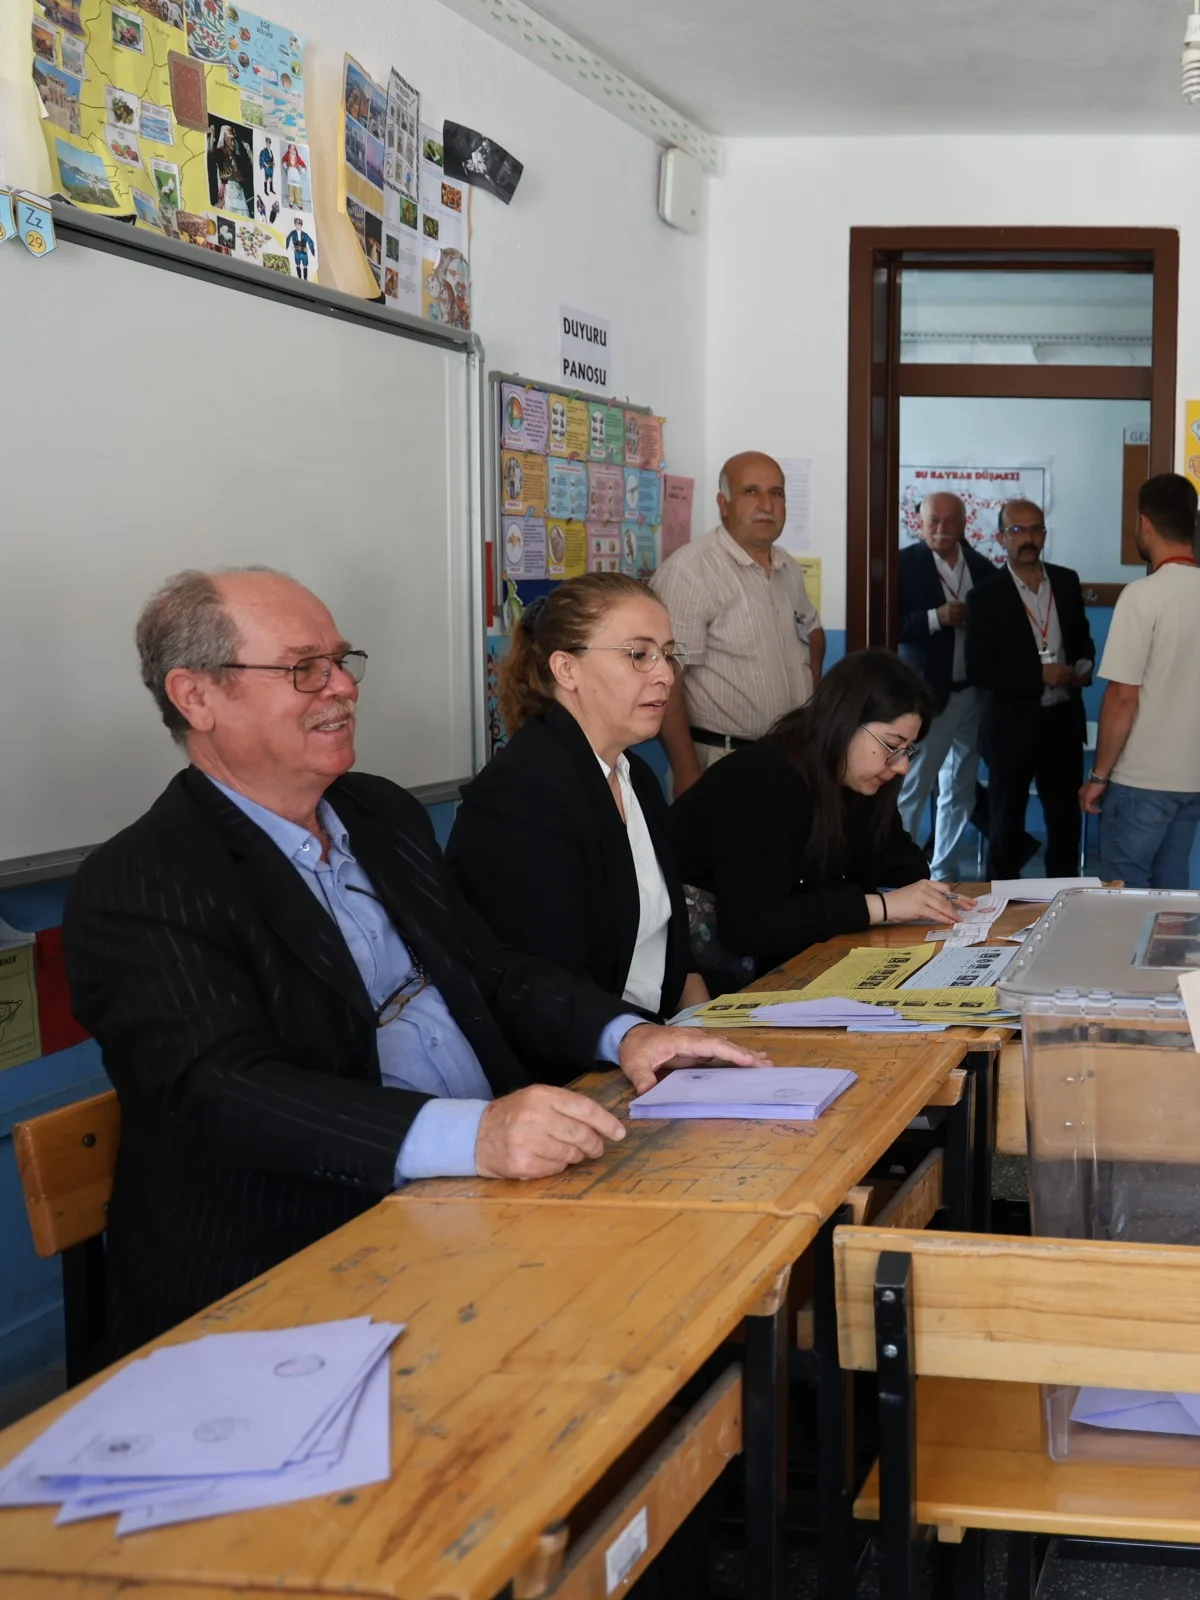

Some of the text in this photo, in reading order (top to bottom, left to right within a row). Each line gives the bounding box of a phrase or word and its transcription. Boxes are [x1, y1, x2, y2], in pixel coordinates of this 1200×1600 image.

[25, 207, 43, 228] Zz
[28, 235, 43, 248] 29
[563, 317, 606, 347] DUYURU
[563, 358, 606, 385] PANOSU
[916, 471, 927, 479] BU
[931, 472, 972, 480] BAYRAK
